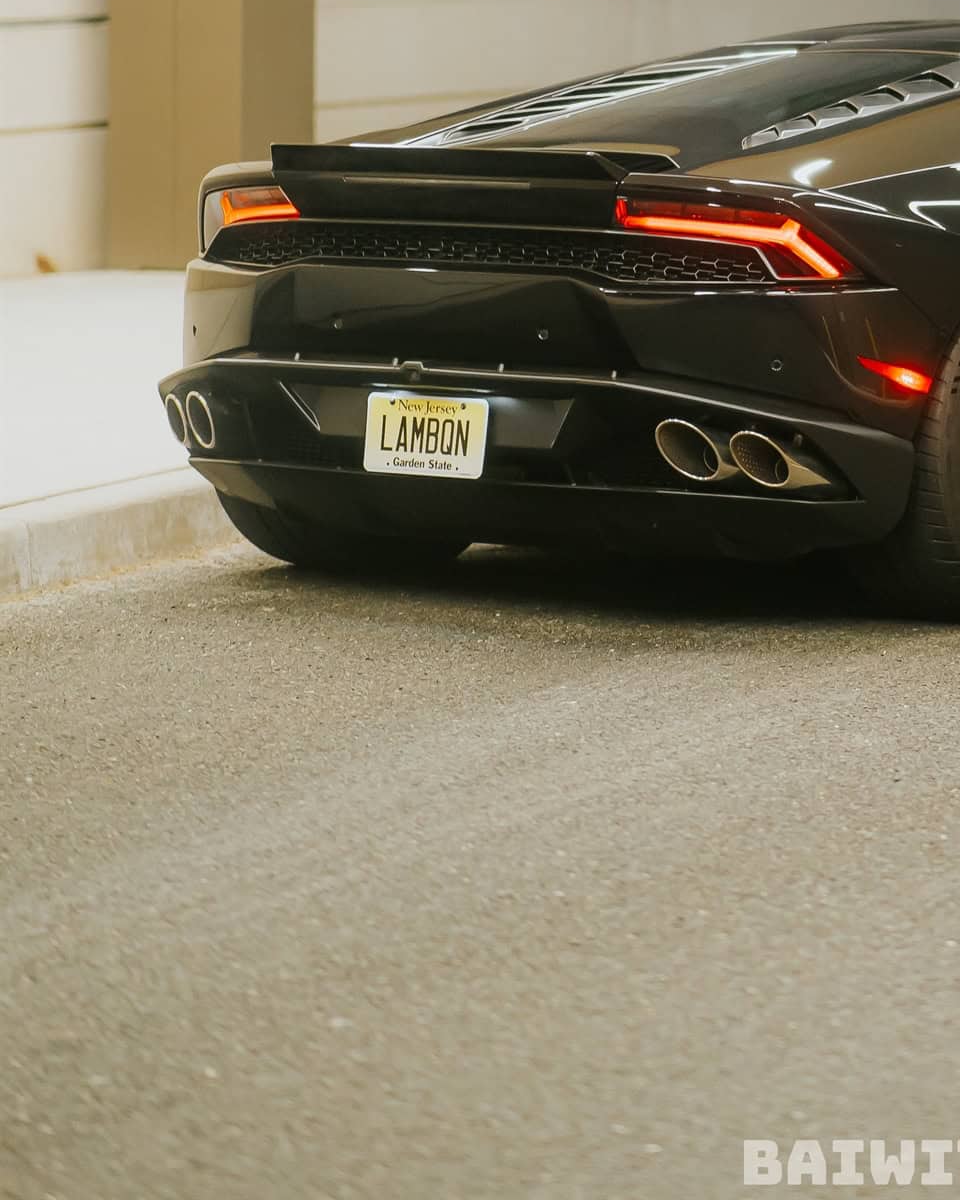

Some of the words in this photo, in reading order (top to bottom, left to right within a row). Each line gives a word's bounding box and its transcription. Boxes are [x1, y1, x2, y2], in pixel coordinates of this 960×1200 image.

[398, 399, 423, 412] New
[424, 401, 458, 417] Jersey
[380, 414, 470, 457] LAMBQN
[393, 457, 425, 469] Garden
[428, 459, 452, 471] State
